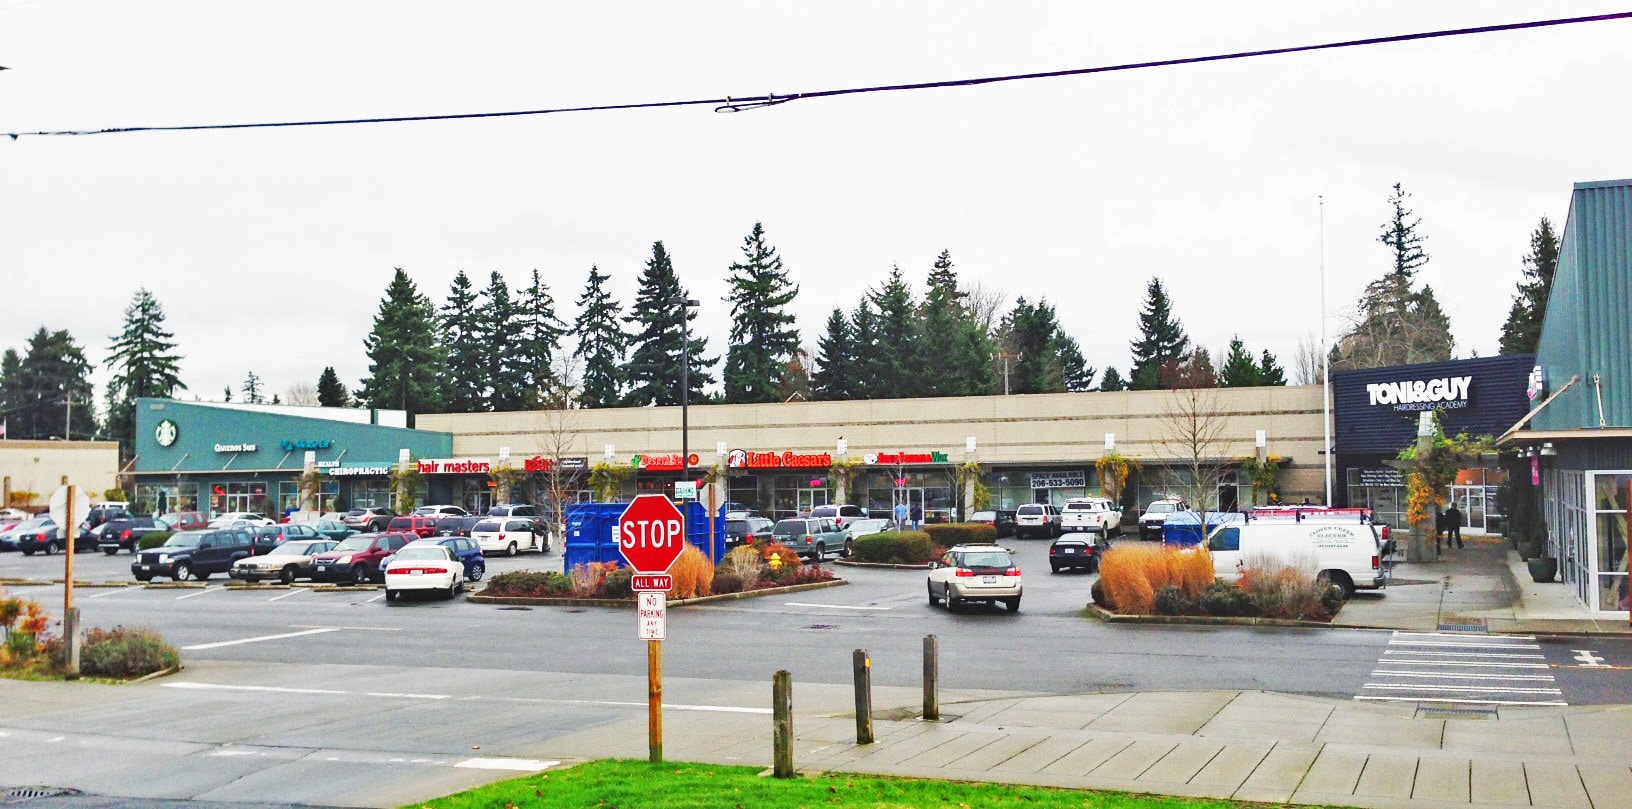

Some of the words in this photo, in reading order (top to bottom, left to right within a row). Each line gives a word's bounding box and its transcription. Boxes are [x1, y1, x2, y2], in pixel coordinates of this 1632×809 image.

[1366, 376, 1472, 405] TONI&GUY
[1393, 402, 1436, 412] HAIRDRESSING
[1437, 401, 1468, 409] ACADEMY
[747, 451, 780, 468] Little
[417, 460, 439, 473] hair
[443, 459, 490, 473] masters
[328, 467, 388, 476] CHIROPRACTIC
[1031, 478, 1084, 488] 206-533-5090
[622, 519, 680, 548] STOP
[635, 579, 650, 588] ALL
[653, 578, 669, 588] WAY
[646, 597, 657, 607] NO
[640, 610, 664, 618] PARKING
